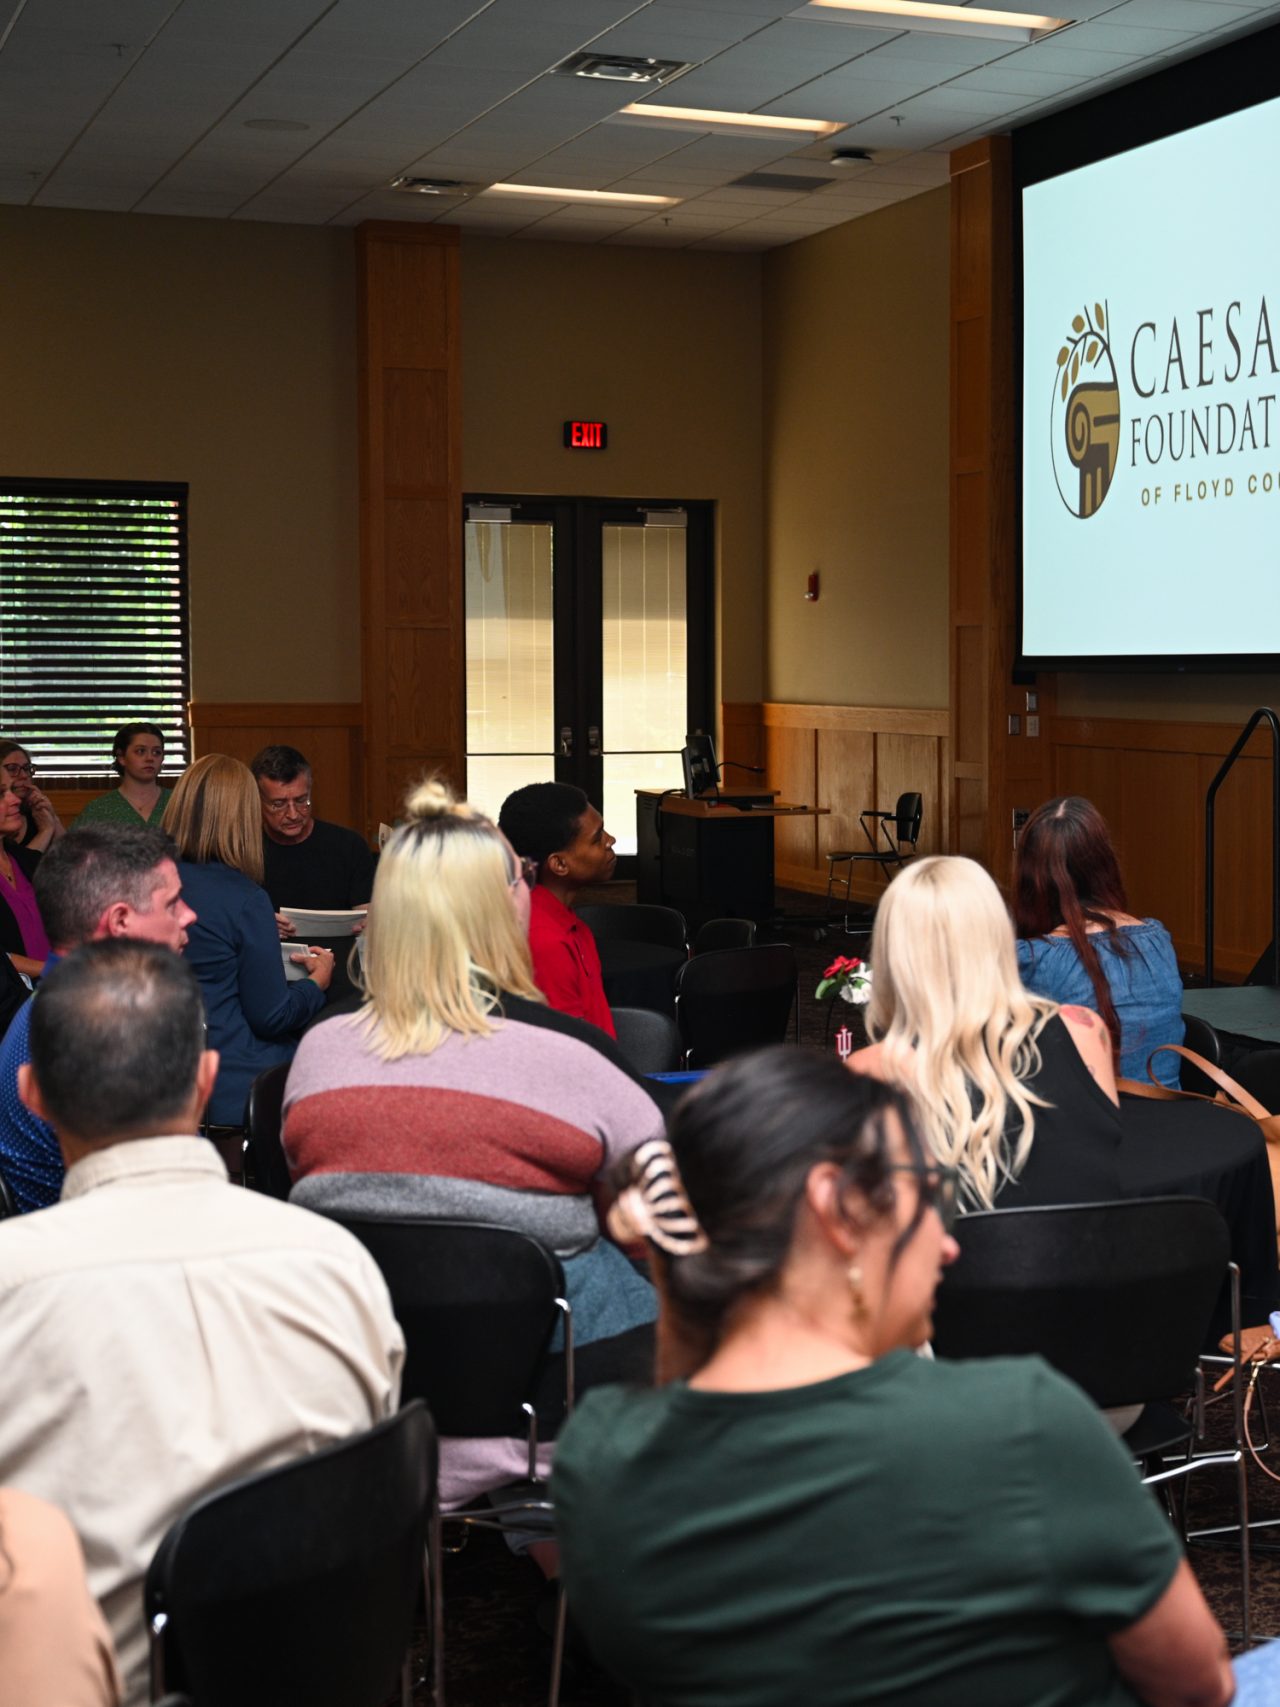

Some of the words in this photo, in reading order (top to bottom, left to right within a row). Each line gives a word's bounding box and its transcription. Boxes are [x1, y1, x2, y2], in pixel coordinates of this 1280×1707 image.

[571, 422, 603, 447] EXIT
[1141, 487, 1161, 506] OF
[1174, 478, 1234, 503] FLOYD
